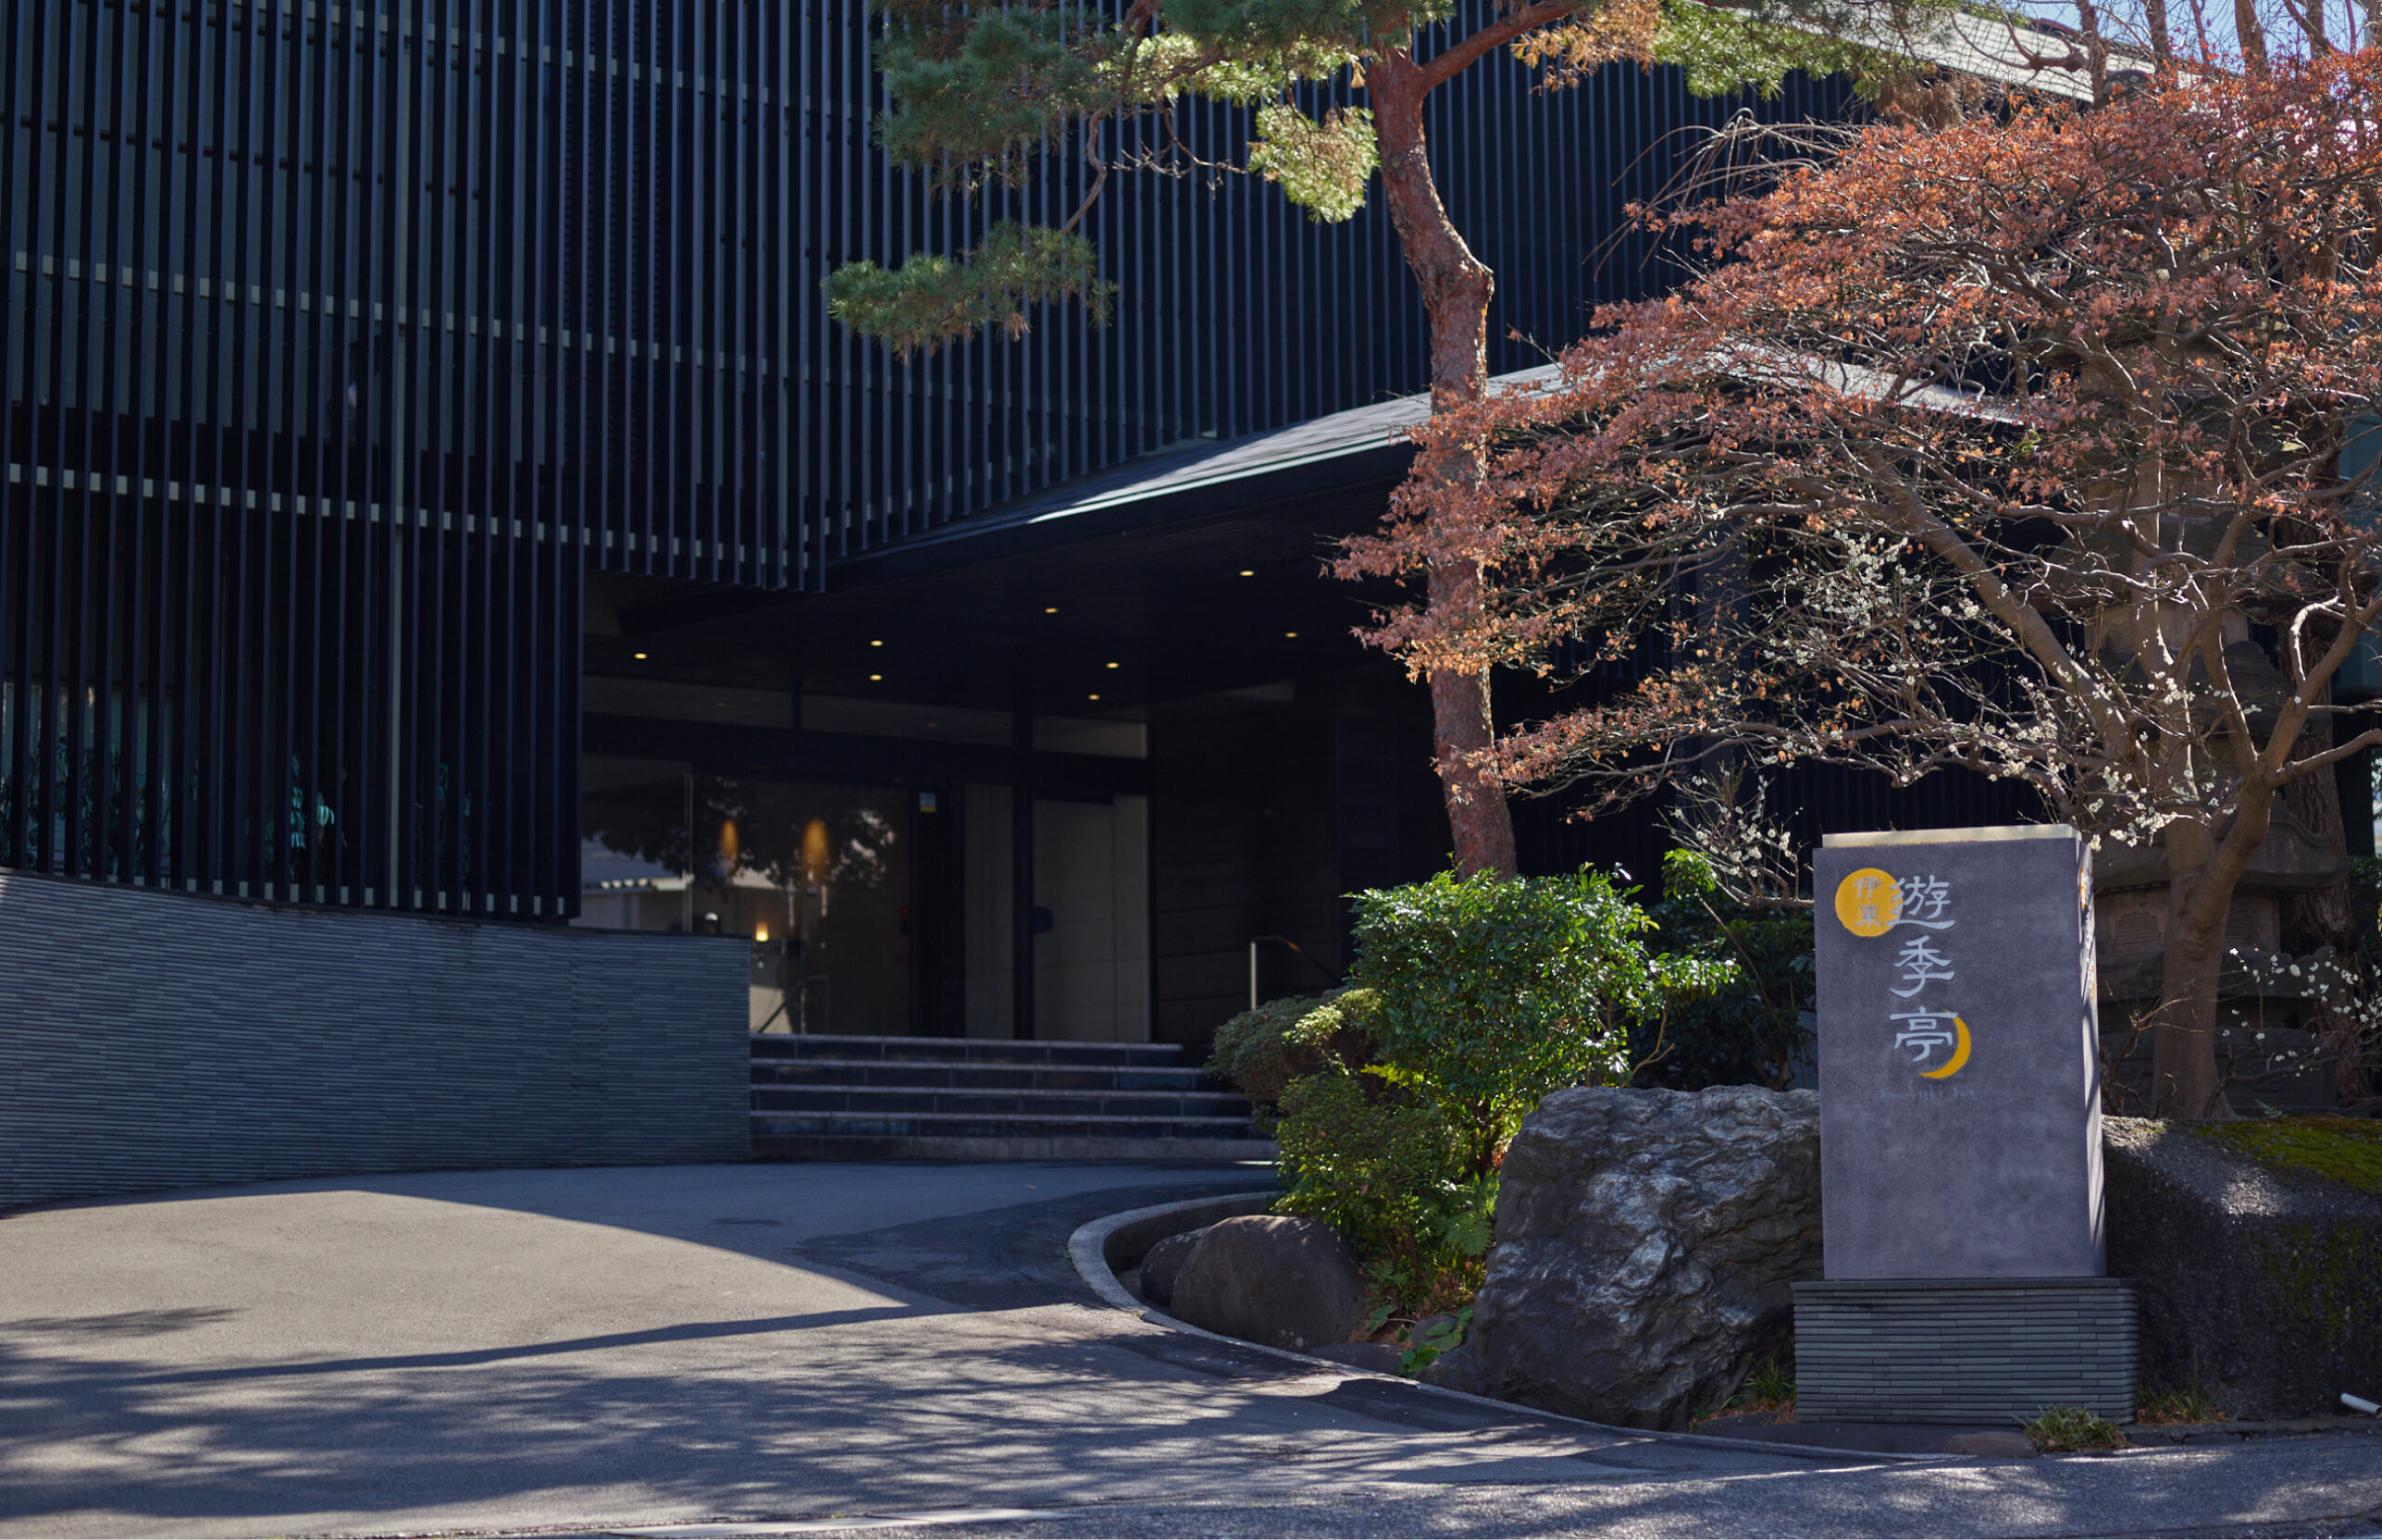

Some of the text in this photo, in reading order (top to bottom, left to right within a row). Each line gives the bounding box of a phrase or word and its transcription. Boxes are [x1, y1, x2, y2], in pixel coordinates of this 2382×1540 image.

[1853, 876, 1883, 928] 伊東
[1887, 874, 1959, 1063] 遊季亭
